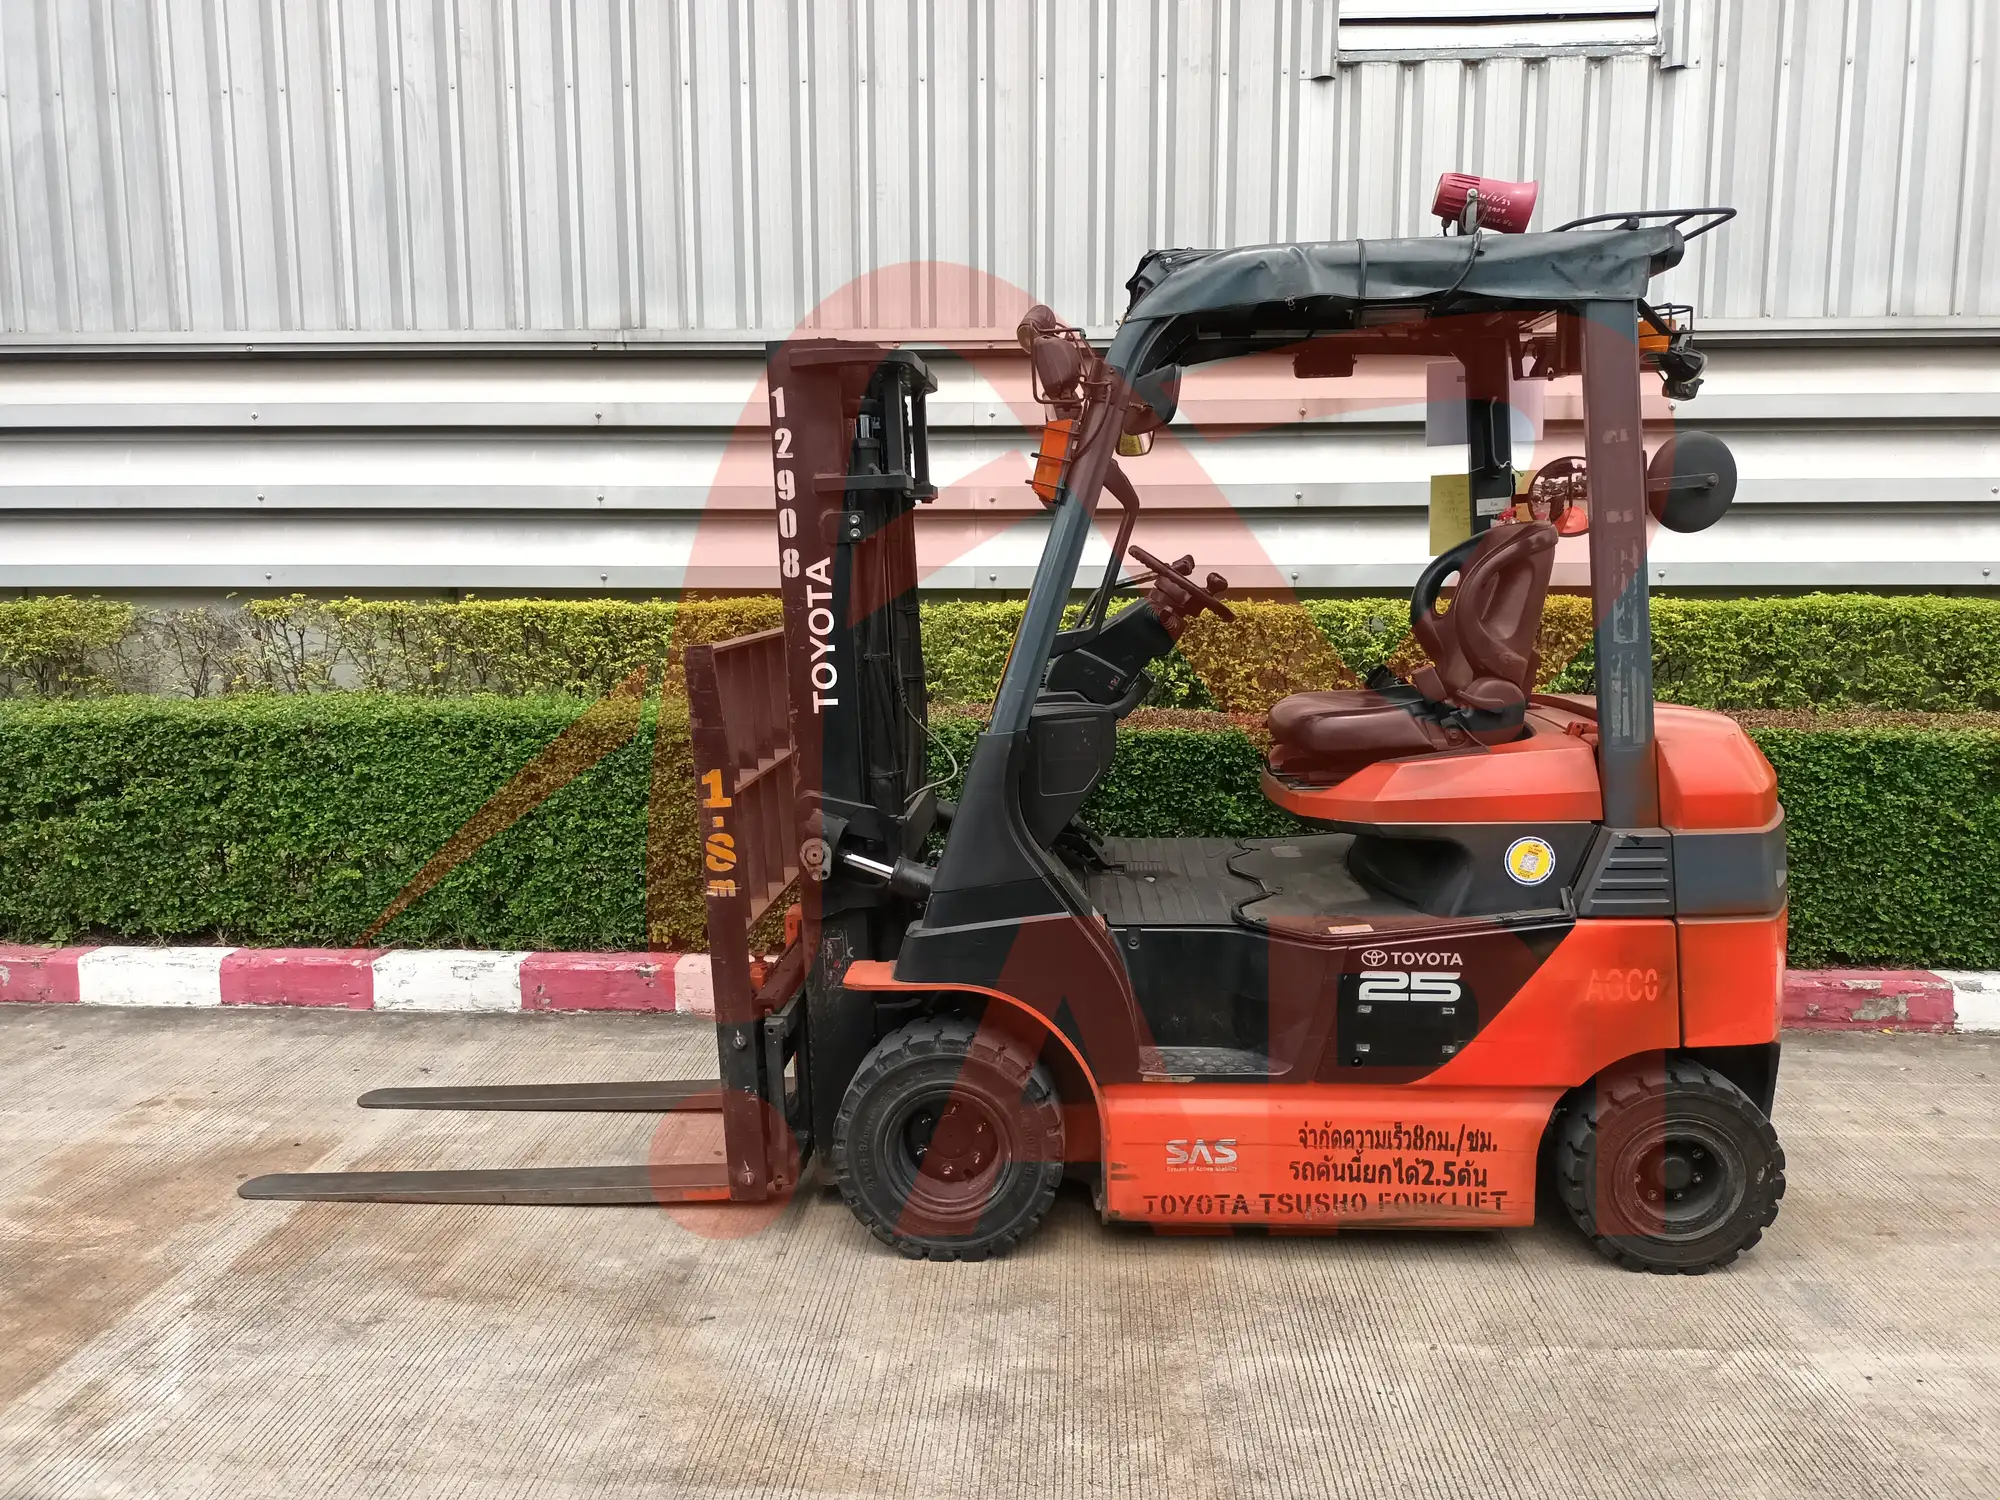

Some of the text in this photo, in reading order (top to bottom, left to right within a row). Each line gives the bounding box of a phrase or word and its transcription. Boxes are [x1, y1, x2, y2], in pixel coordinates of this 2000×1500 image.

[771, 387, 800, 578] 12908
[805, 557, 839, 713] TOYOTA
[1391, 952, 1463, 966] TOYOTA
[1358, 971, 1461, 1002] 25
[1166, 1138, 1238, 1164] SAS
[1142, 1194, 1250, 1216] TOYOTA
[1259, 1192, 1369, 1216] TSUSHO
